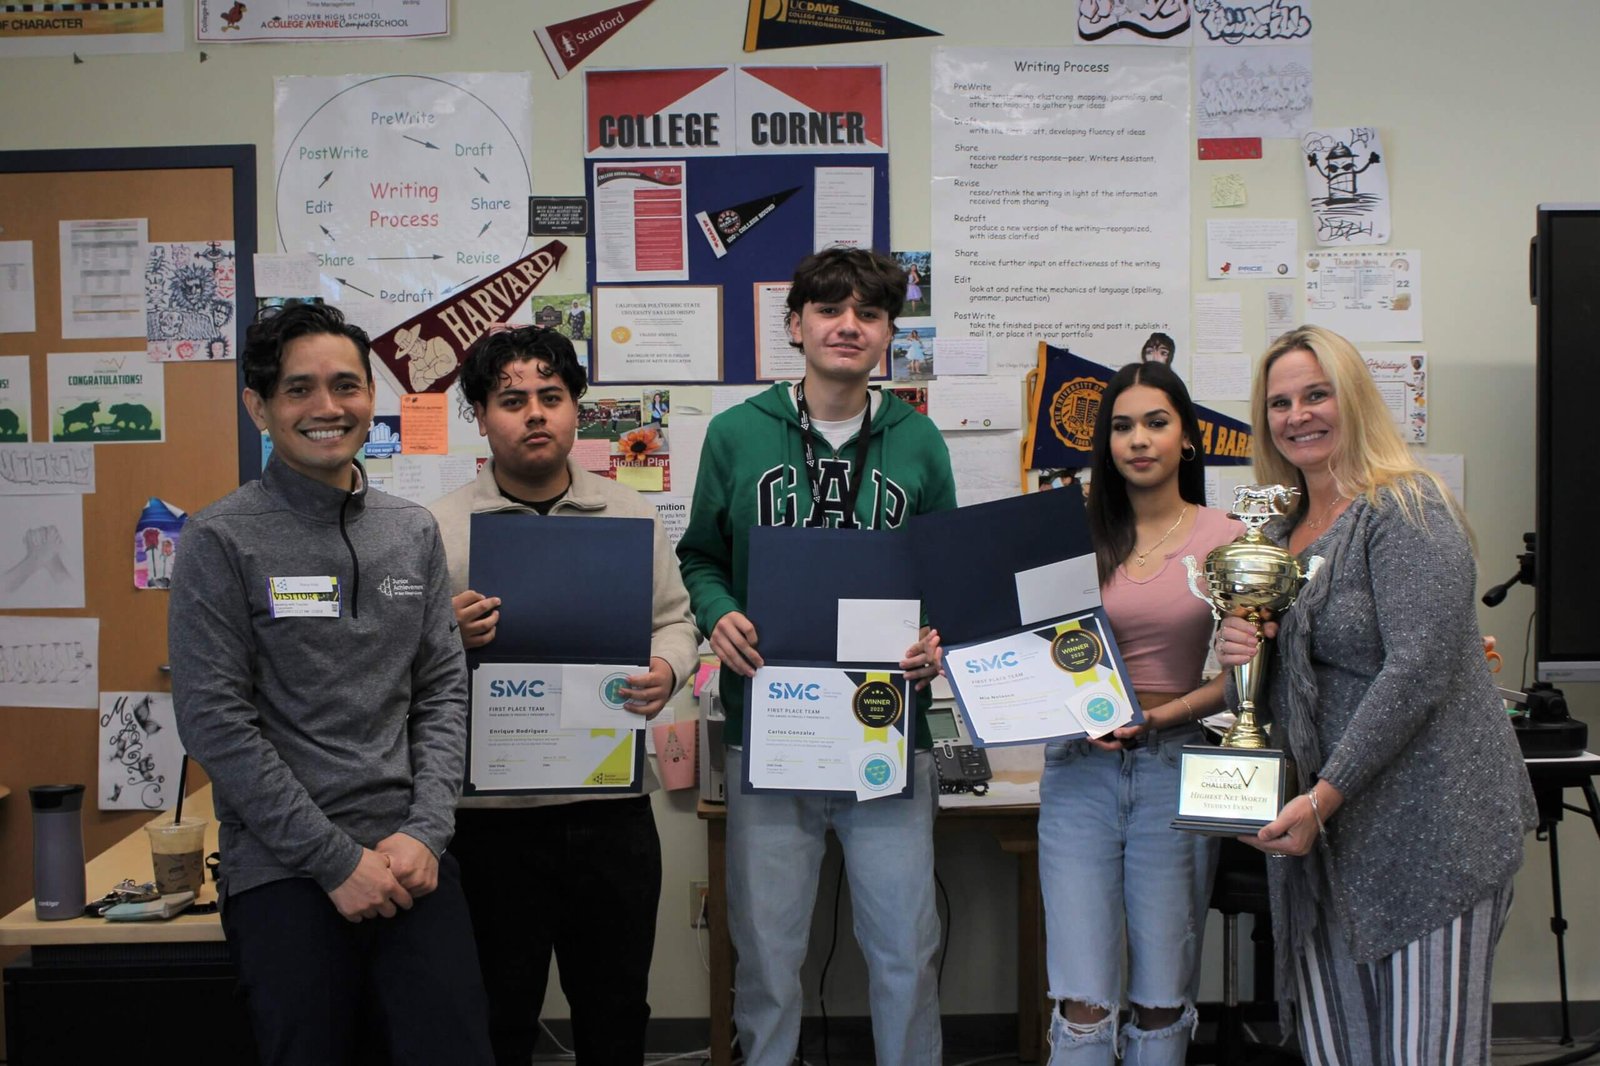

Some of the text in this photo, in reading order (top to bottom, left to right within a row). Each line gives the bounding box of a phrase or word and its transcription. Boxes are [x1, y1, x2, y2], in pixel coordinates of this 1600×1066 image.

[12, 18, 83, 30] CHARACTER
[788, 11, 873, 27] COLLEGE AGRICULTURAL
[576, 11, 625, 44] Stanford
[798, 20, 886, 35] ENVIRONMENTAL SCIENCES
[1014, 60, 1109, 76] Writing Process
[953, 82, 991, 91] PreWrite
[371, 112, 435, 125] PreWrite
[599, 111, 866, 149] COLLEGE CORNER
[299, 146, 369, 160] PostWrite
[455, 143, 493, 157] Draft
[954, 144, 978, 152] Share
[954, 179, 980, 188] Revise
[370, 181, 439, 203] Writing
[1036, 190, 1062, 199] writing
[1072, 190, 1089, 199] light
[306, 200, 333, 214] Edit
[471, 197, 511, 210] Share
[1022, 198, 1049, 207] sharing
[370, 210, 439, 227] Process
[954, 214, 986, 222] Redraft
[969, 225, 998, 234] produce
[456, 251, 500, 264] Revise
[954, 249, 978, 257] Share
[318, 254, 355, 267] Share
[1028, 260, 1046, 269] input
[1135, 260, 1160, 269] writing
[954, 276, 971, 284] Edit
[1306, 281, 1318, 289] 21
[1396, 280, 1410, 288] 22
[1098, 286, 1129, 296] language
[437, 251, 554, 351] HARVARD
[1005, 295, 1050, 304] punctuation)
[954, 312, 995, 320] PostWrite
[1033, 322, 1053, 331] piece
[1064, 322, 1090, 332] writing
[1106, 322, 1122, 332] post
[1134, 322, 1160, 332] publish
[969, 330, 984, 338] mail
[1006, 330, 1025, 340] place
[1026, 330, 1033, 338] it
[1034, 330, 1042, 338] in
[1043, 332, 1059, 340] your
[1061, 330, 1093, 340] portfolio
[68, 374, 143, 386] CONGRATULATIONS!
[757, 459, 908, 529] GAP
[274, 593, 316, 601] VISITOR
[1061, 643, 1089, 655] WINNER
[965, 651, 1018, 674] SMC
[490, 679, 545, 698] SMC
[768, 682, 820, 701] SMC
[863, 698, 891, 706] WINNER
[1201, 781, 1242, 790] CHALLENGE
[1190, 791, 1268, 803] HIGHEST NET WORTH
[1203, 801, 1254, 811] STUDENT EVENT
